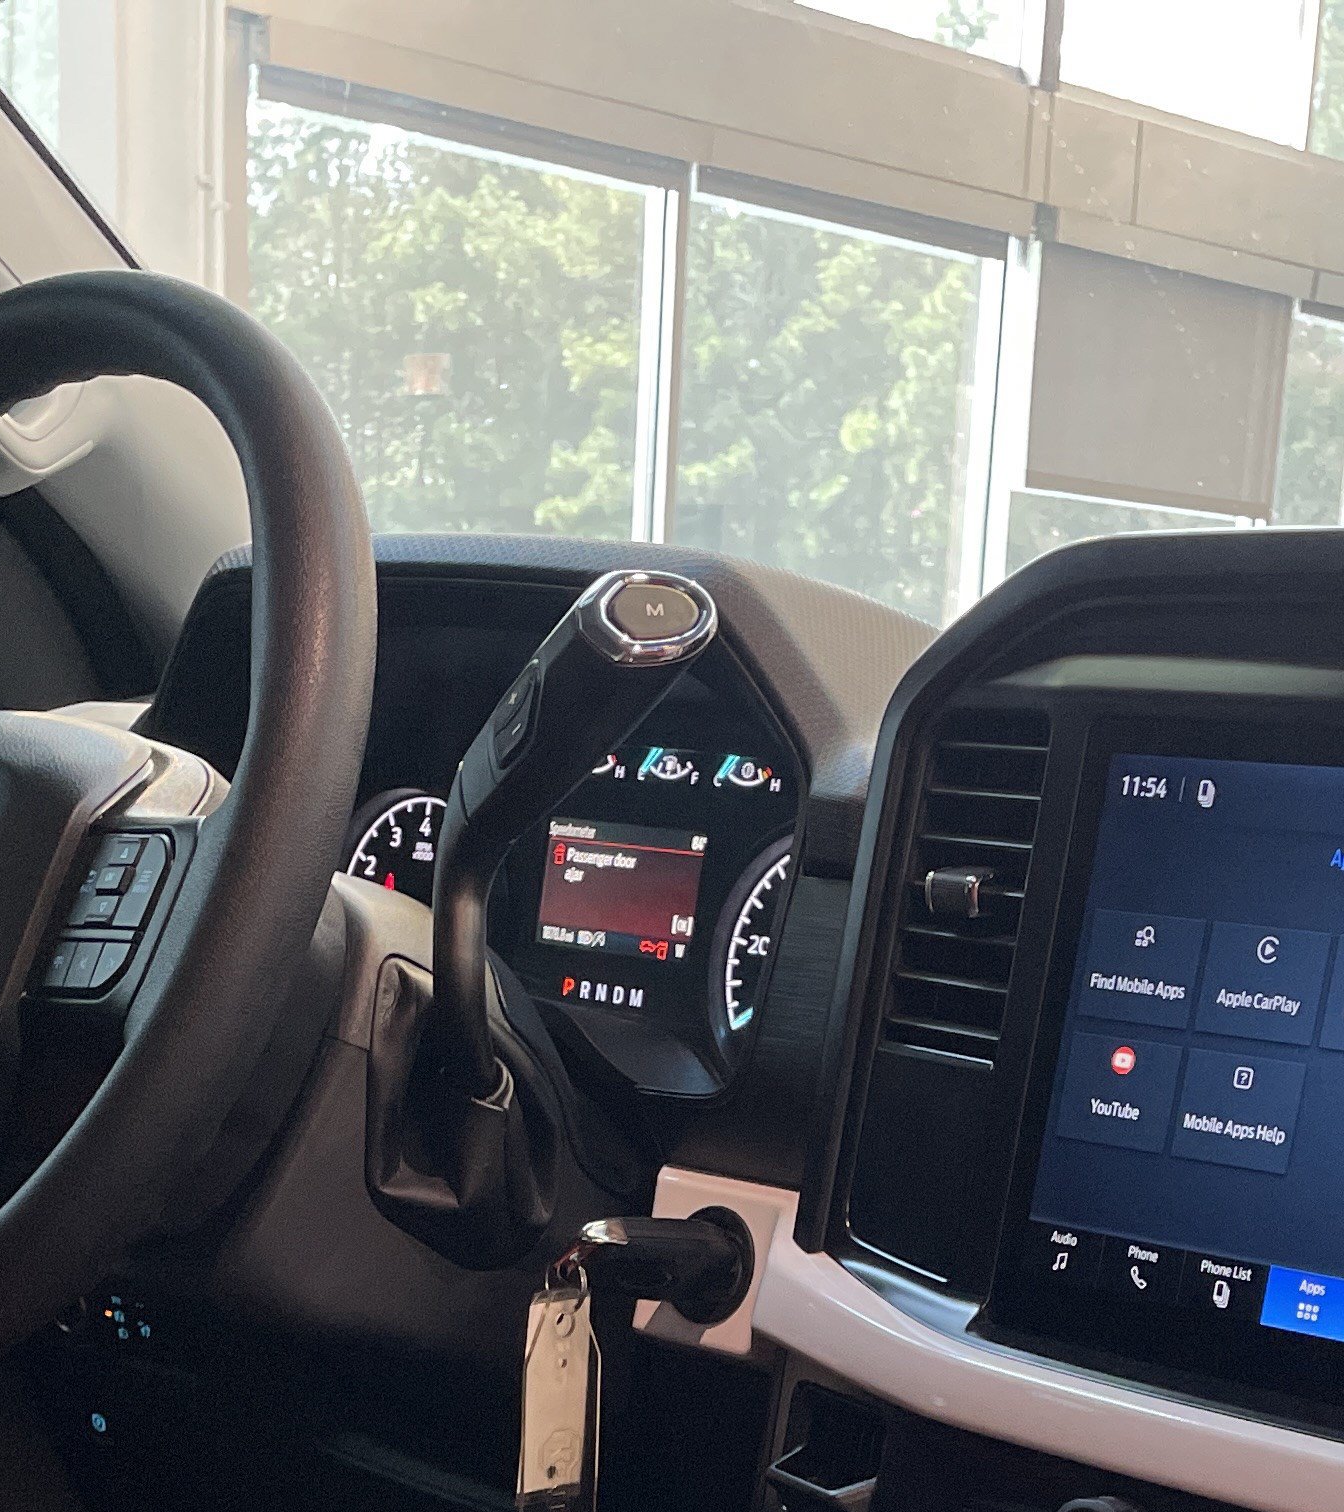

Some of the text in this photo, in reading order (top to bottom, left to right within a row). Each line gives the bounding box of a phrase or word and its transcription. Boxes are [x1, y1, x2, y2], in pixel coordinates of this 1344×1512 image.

[645, 603, 665, 617] M
[769, 778, 782, 792] H
[1121, 774, 1167, 799] 11:54
[390, 826, 403, 849] 3
[419, 816, 432, 838] 4
[364, 854, 377, 876] 2
[566, 847, 638, 869] Passenger door
[563, 866, 585, 883] ajar
[562, 976, 644, 1008] P R N D M
[1089, 971, 1186, 1001] Find Mobile Apps
[1215, 988, 1302, 1016] Apple CarPlay
[1090, 1097, 1140, 1121] YouTube
[1182, 1112, 1287, 1146] Mobile Apps Help
[1050, 1230, 1078, 1247] Audio
[1127, 1244, 1159, 1263] Phone
[1200, 1258, 1253, 1282] Phone List
[1298, 1279, 1326, 1297] Apps
